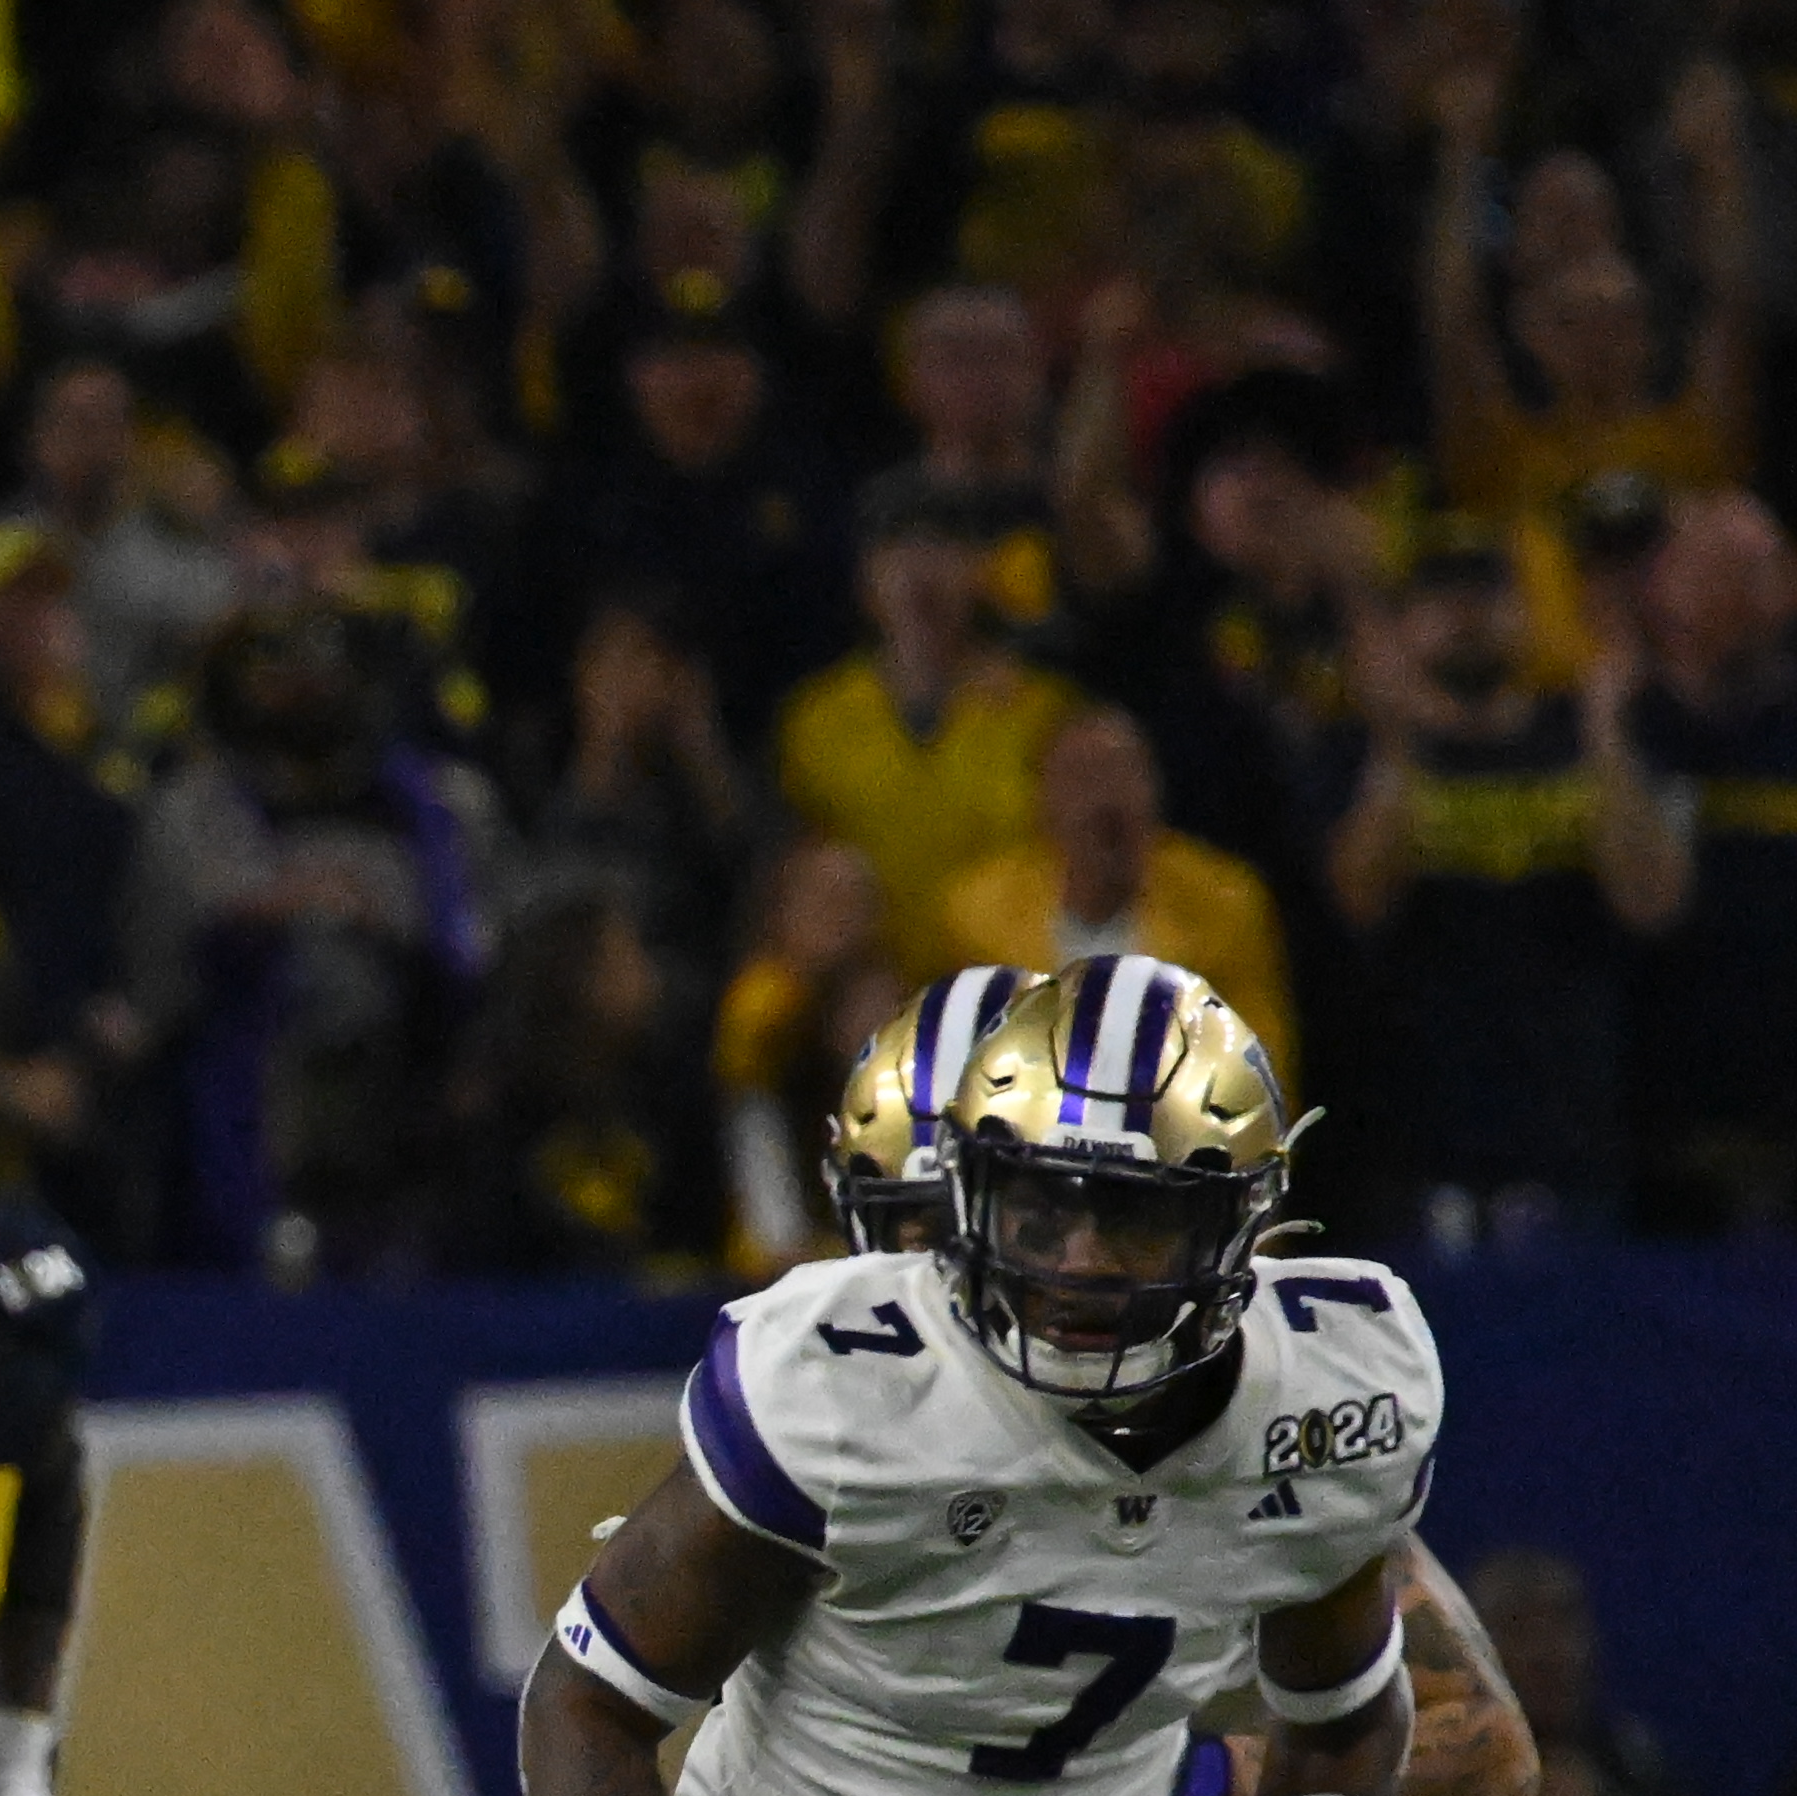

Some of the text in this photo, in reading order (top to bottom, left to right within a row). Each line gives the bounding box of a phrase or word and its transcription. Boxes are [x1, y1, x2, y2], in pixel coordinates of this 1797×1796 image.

[1263, 1392, 1403, 1478] 2024
[1115, 1493, 1158, 1526] W
[969, 1602, 1175, 1780] 7
